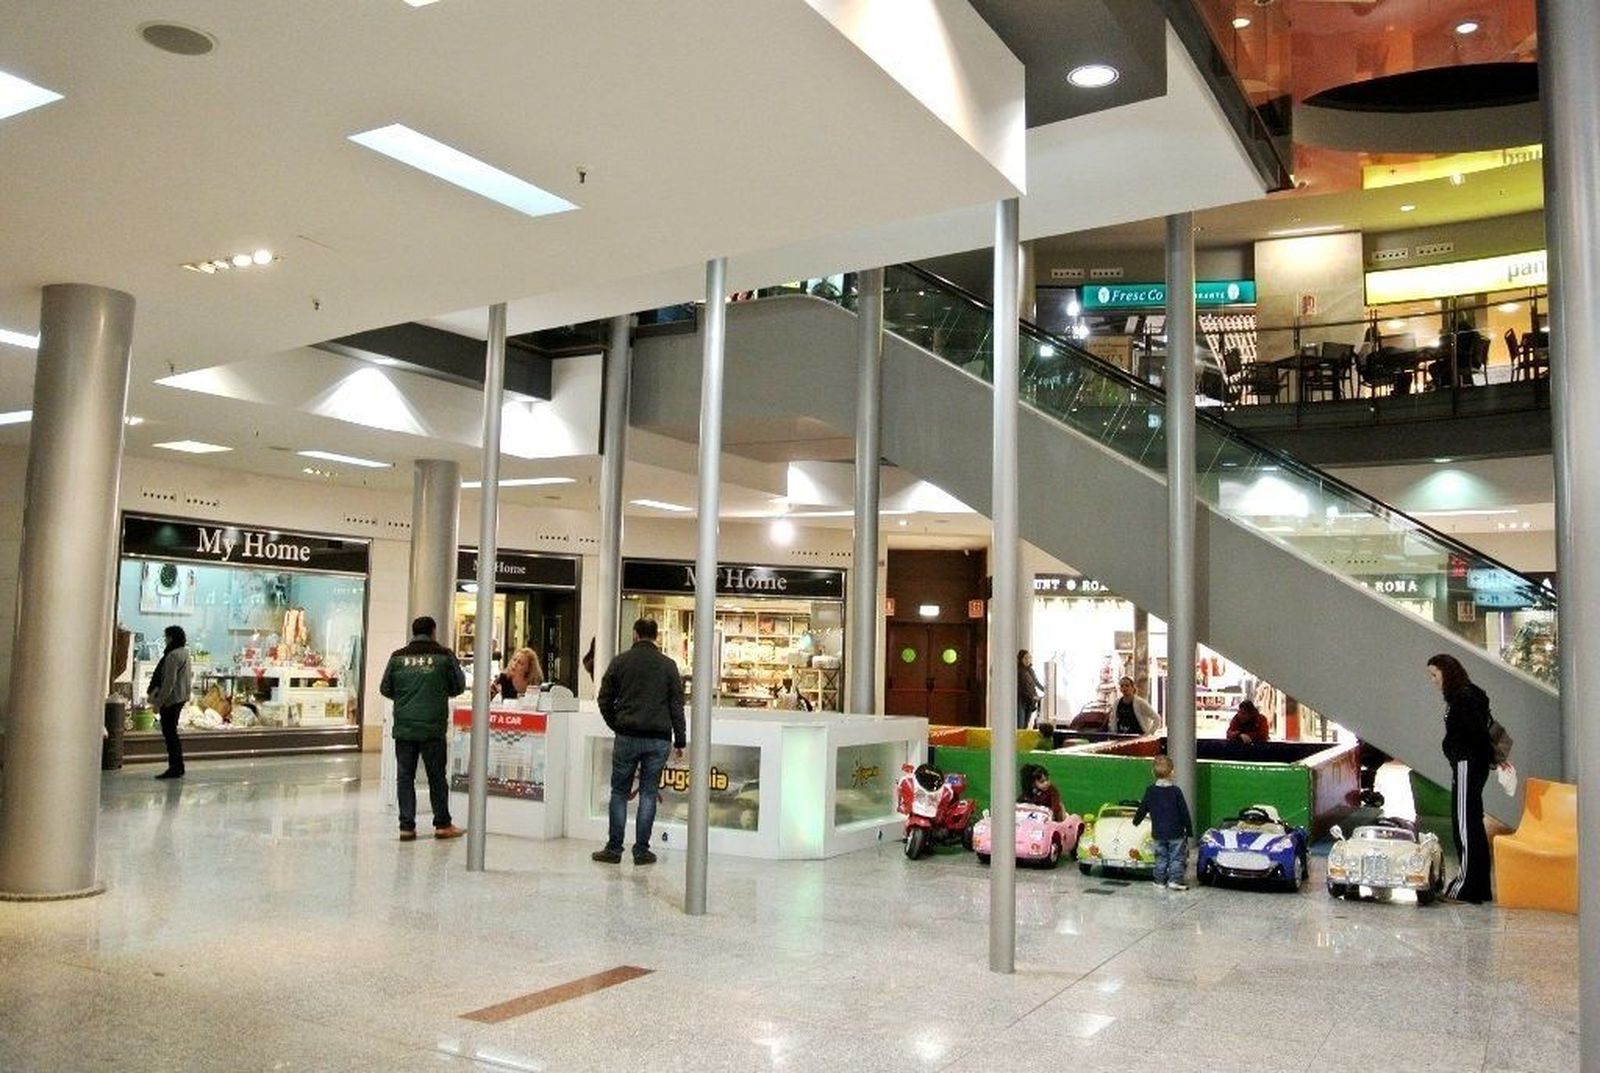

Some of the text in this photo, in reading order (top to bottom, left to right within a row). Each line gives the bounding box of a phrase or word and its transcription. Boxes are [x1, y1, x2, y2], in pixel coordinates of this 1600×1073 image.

[196, 528, 311, 562] My Home
[495, 561, 526, 574] Home
[724, 568, 787, 591] Home
[1034, 579, 1060, 590] UNT
[1374, 580, 1418, 593] ROMA
[505, 716, 522, 726] CAR
